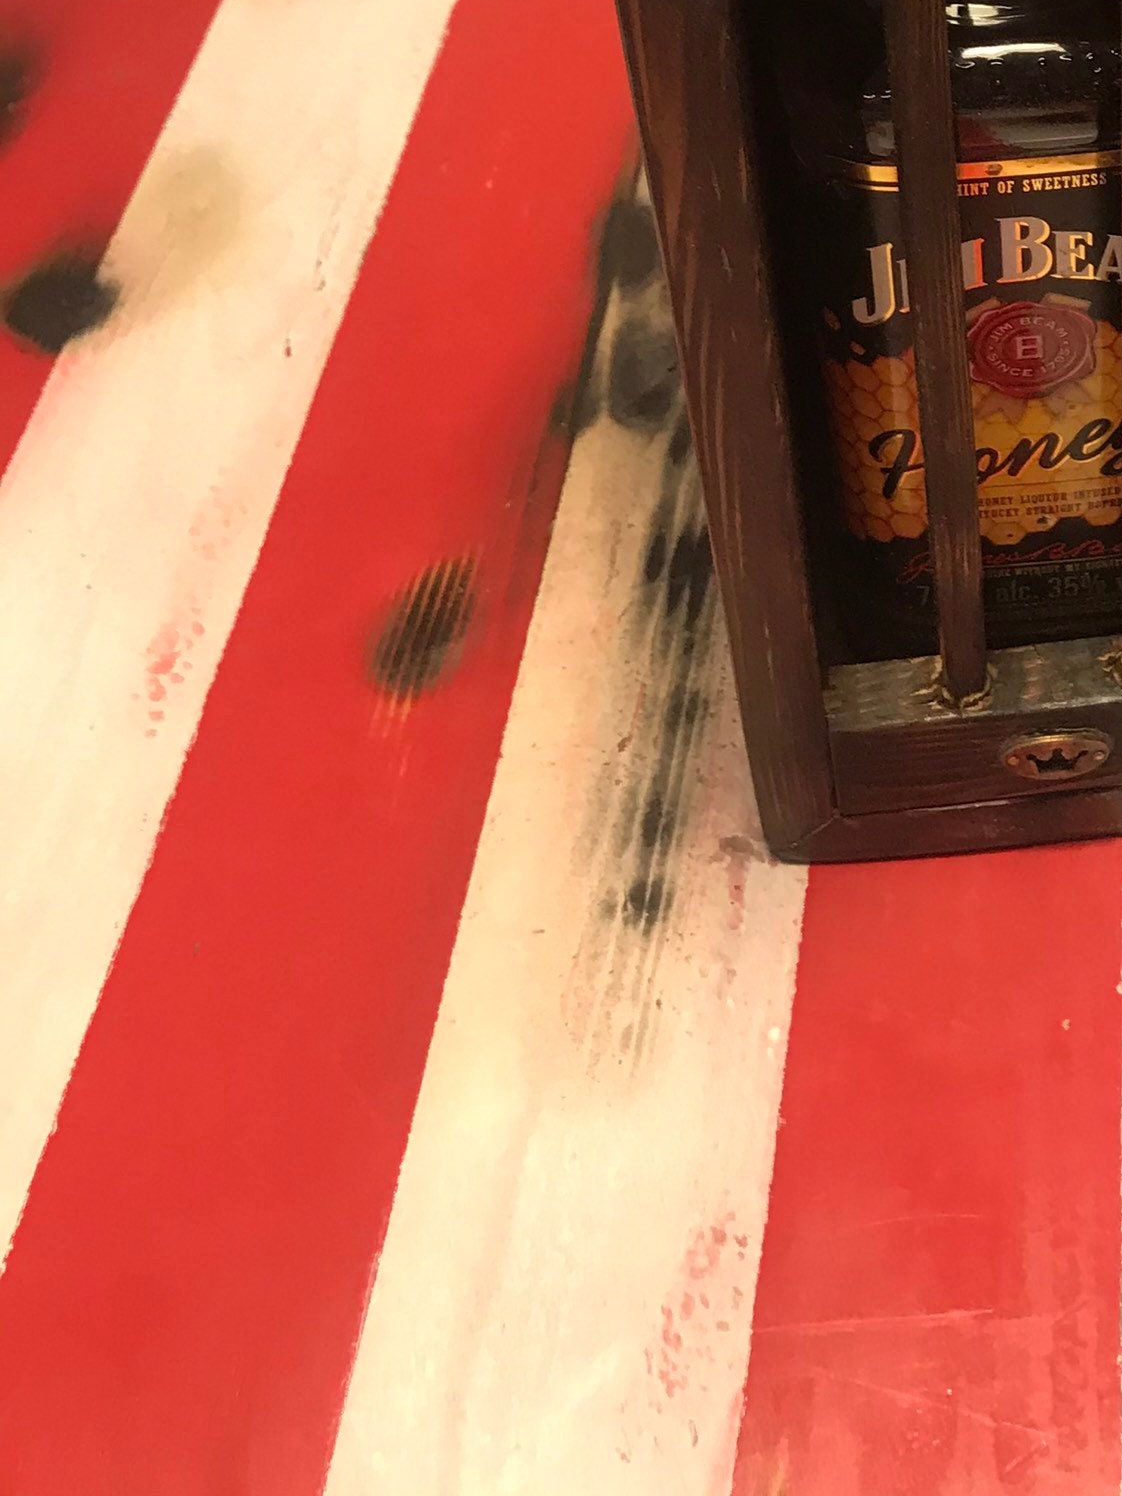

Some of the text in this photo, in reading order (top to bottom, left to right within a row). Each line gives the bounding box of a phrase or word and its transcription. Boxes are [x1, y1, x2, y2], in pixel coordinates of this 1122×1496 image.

[997, 179, 1015, 194] OF
[1022, 172, 1107, 193] SWEETNESS
[989, 316, 1068, 343] JIM BEAM
[988, 352, 1034, 377] SINCE
